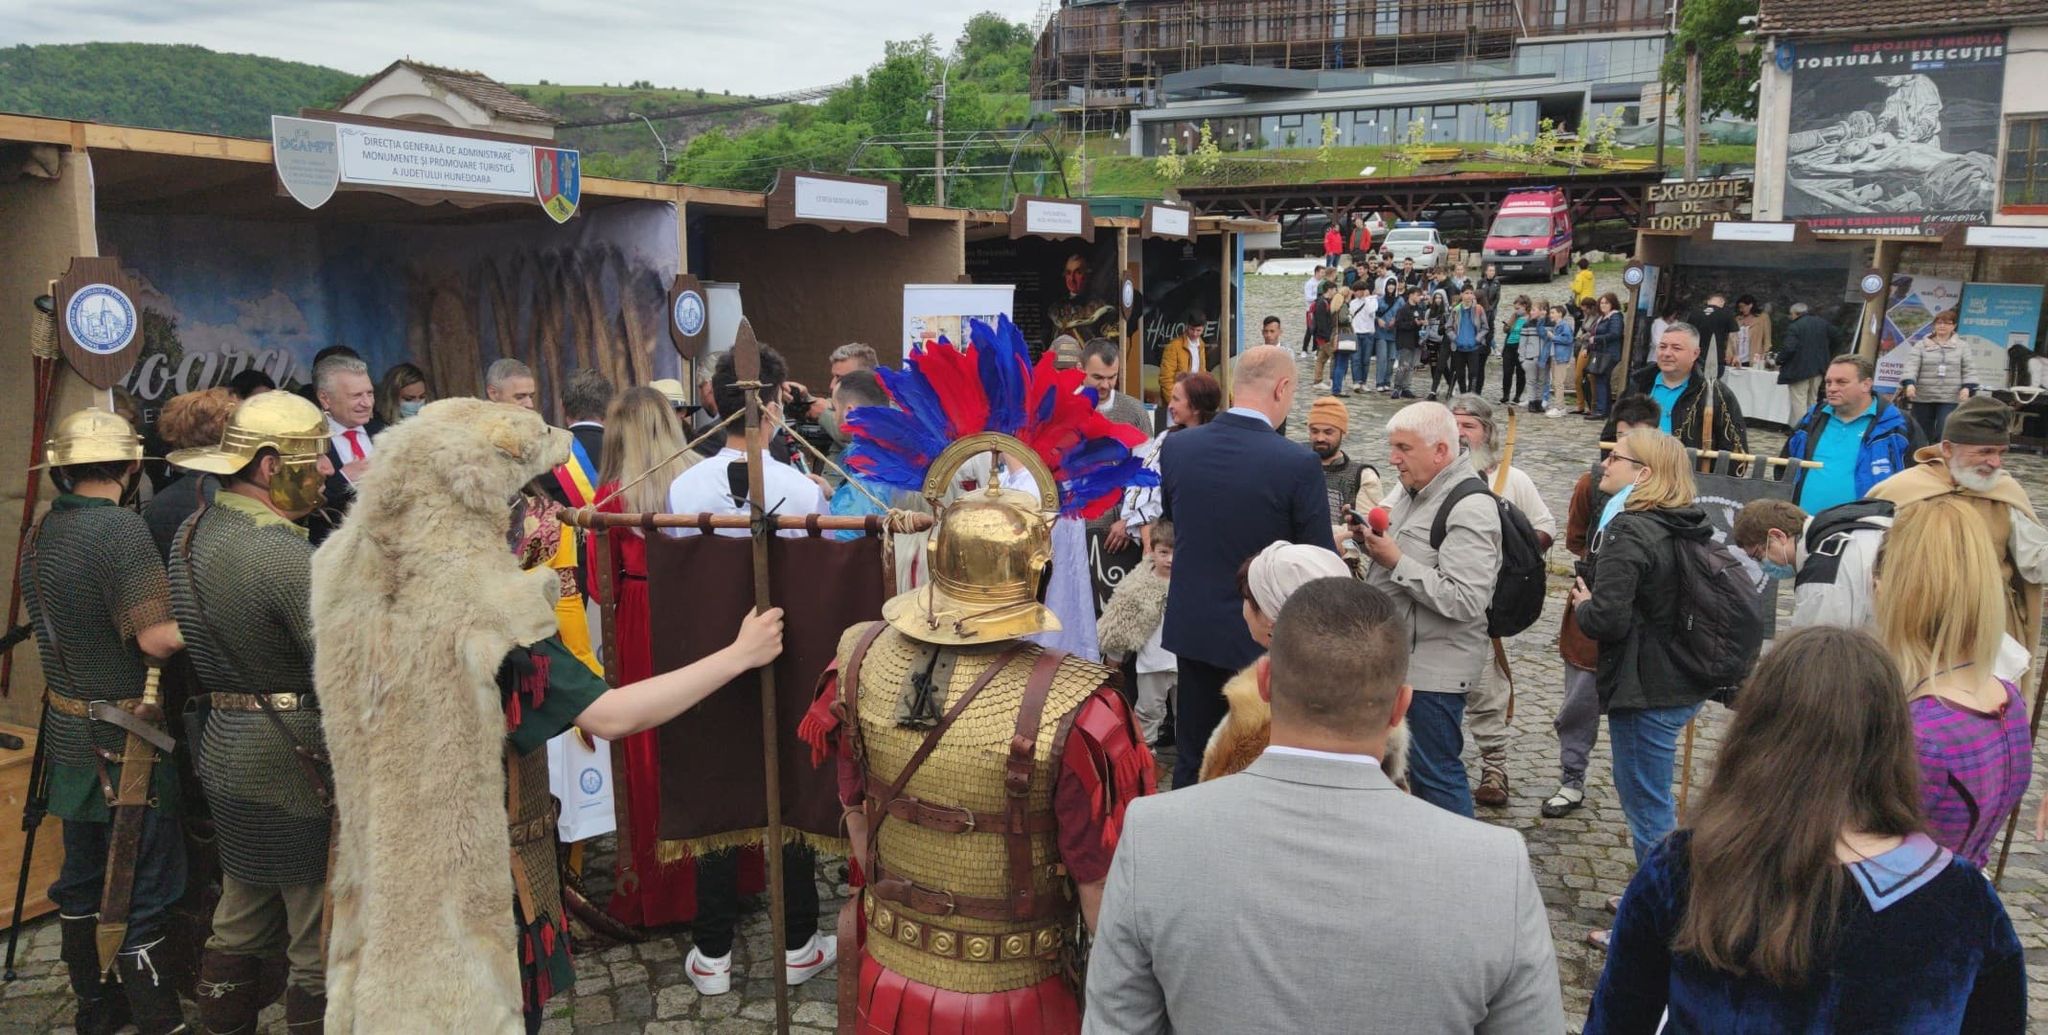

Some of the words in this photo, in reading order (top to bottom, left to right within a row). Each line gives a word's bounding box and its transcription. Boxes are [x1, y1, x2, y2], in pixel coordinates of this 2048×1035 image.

[1797, 51, 1883, 69] TORTURĂ
[364, 136, 402, 149] DIRECȚIA
[403, 141, 444, 153] GENERALĂ
[446, 146, 456, 155] DE
[458, 148, 512, 160] ADMINISTRARE
[362, 151, 418, 165] MONUMENTE
[429, 158, 477, 170] PROMOVARE
[479, 162, 515, 173] TURISTICĂ
[392, 167, 398, 175] A
[444, 172, 491, 183] HUNEDOARA
[1681, 201, 1702, 213] DE
